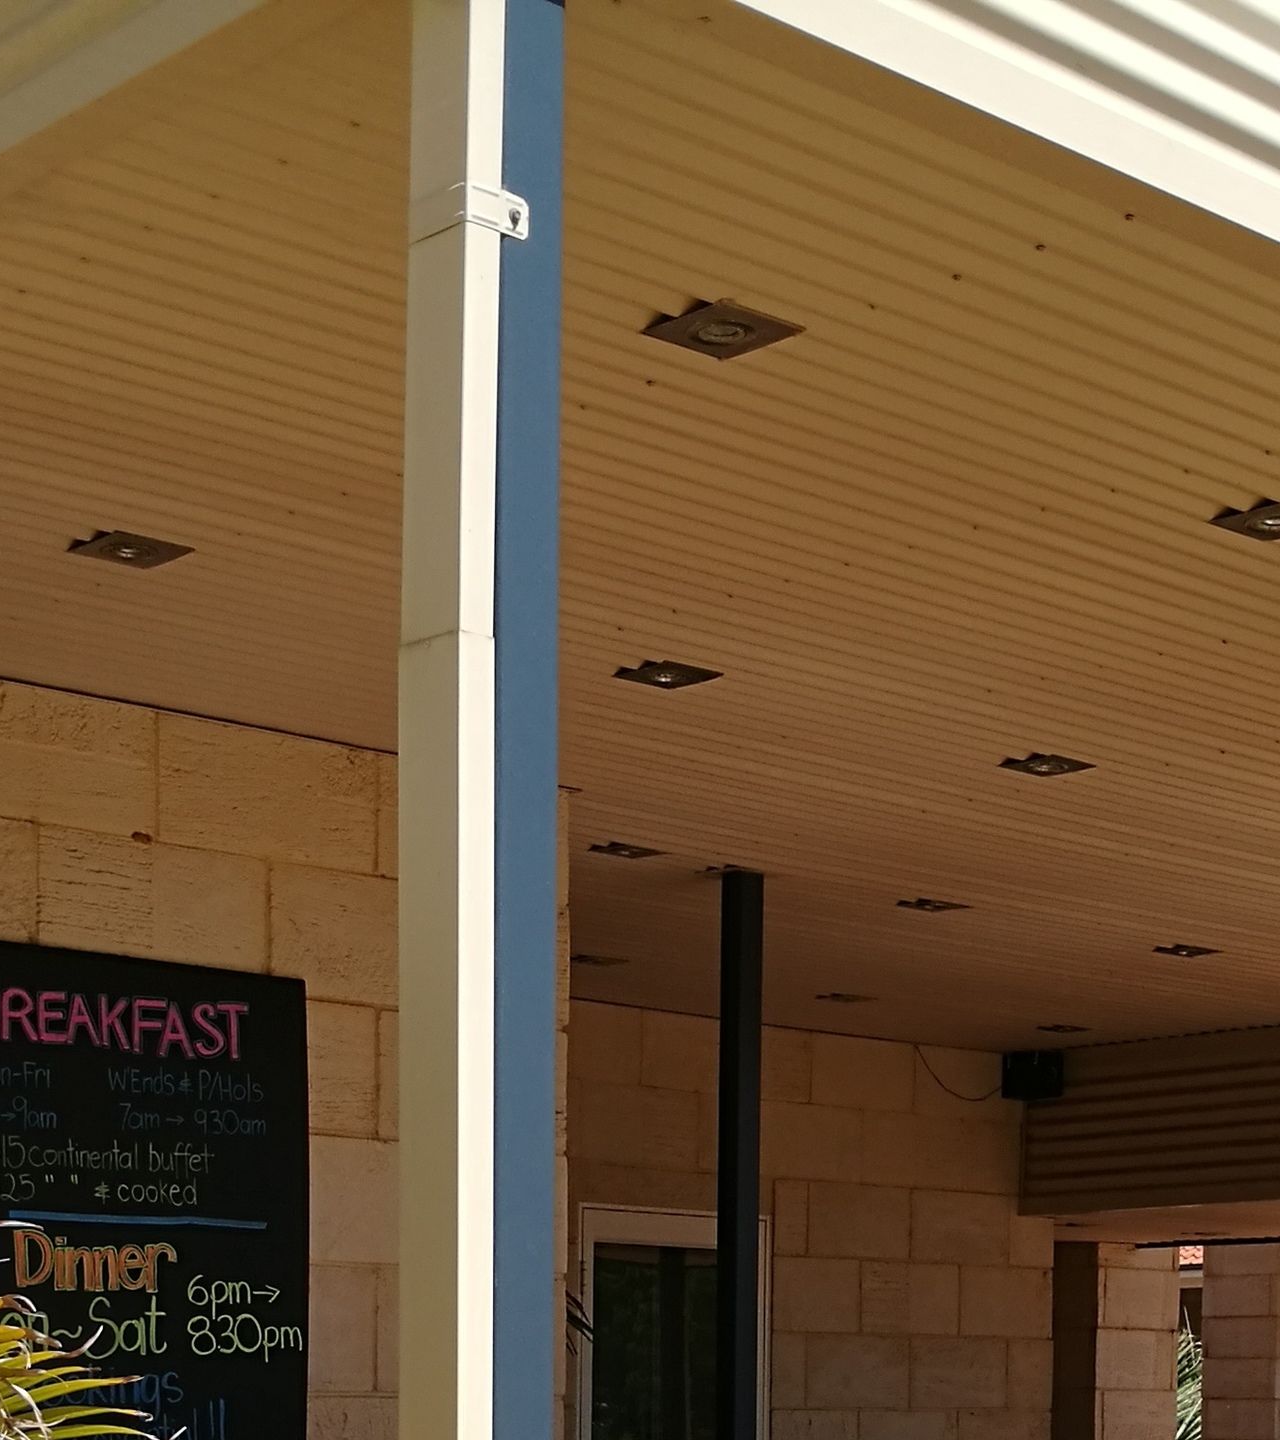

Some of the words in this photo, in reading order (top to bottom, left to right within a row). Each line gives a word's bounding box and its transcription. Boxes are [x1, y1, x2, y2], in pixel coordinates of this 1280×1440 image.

[198, 1068, 264, 1102] P/Hols
[12, 1095, 57, 1130] 9am
[119, 1102, 160, 1130] 7am
[27, 1138, 138, 1170] continental
[148, 1142, 215, 1179] buffet
[117, 1178, 198, 1206] cooked
[12, 1228, 178, 1293] Dinner
[187, 1274, 251, 1320] 6pm
